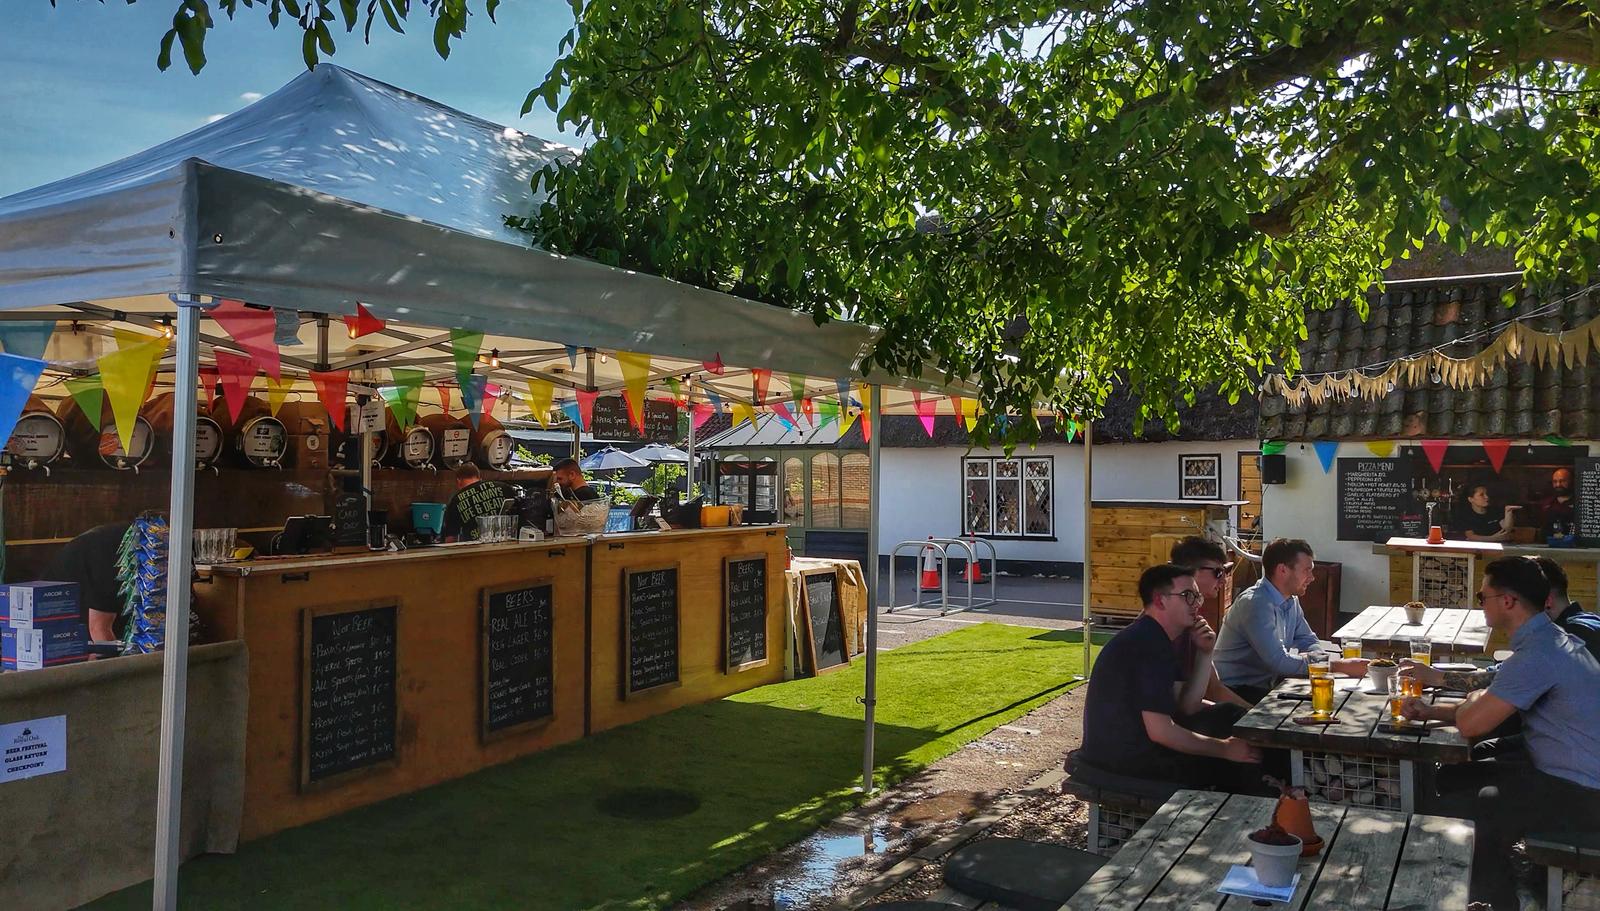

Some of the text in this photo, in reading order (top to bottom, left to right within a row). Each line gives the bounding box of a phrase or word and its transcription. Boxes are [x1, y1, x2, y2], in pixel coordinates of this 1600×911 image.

[1358, 462, 1395, 471] PIZZA MENU
[480, 481, 495, 491] IT'S
[472, 487, 503, 504] ALWAYS
[462, 507, 475, 524] LIFE
[475, 503, 482, 514] &
[43, 590, 71, 598] ARCORC
[506, 590, 535, 609] BEERS
[492, 617, 510, 634] REAL
[6, 742, 47, 755] BEER FESTIVAL
[5, 751, 48, 763] GLASS RETURN
[7, 761, 44, 773] CHECKPOINT
